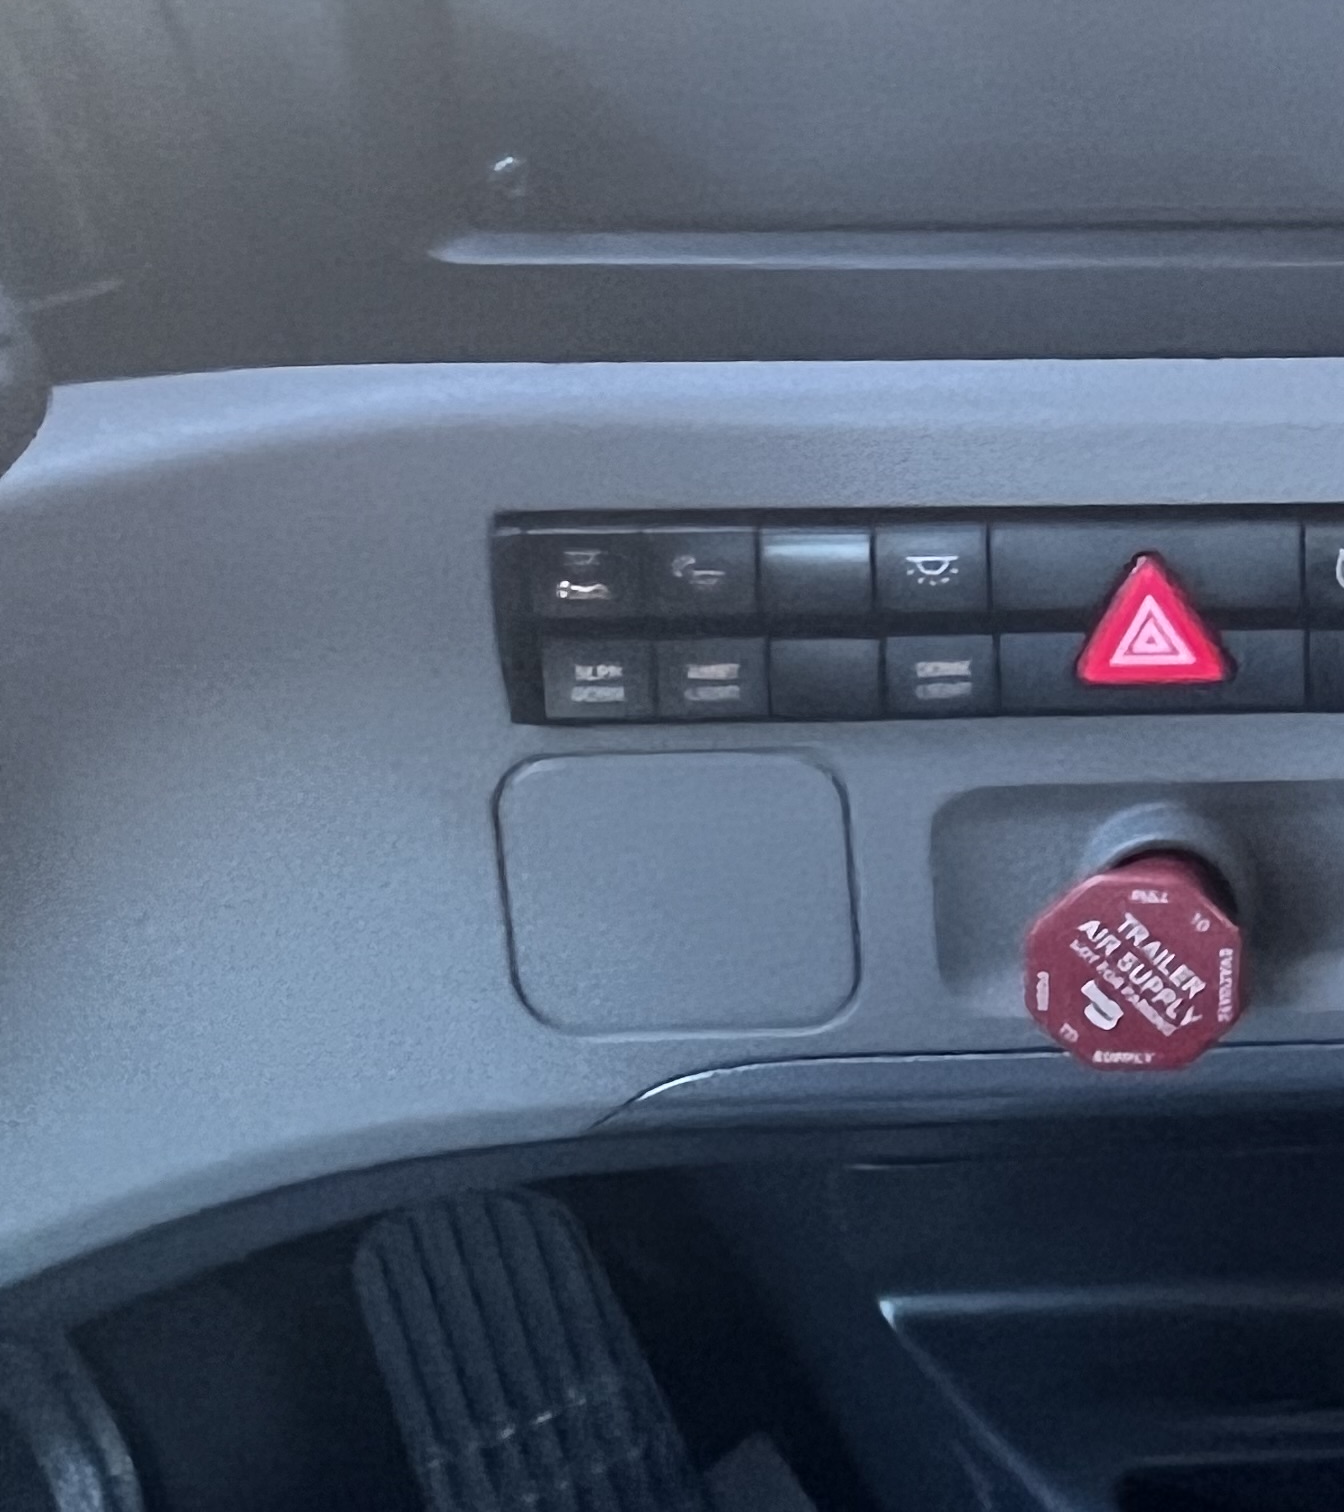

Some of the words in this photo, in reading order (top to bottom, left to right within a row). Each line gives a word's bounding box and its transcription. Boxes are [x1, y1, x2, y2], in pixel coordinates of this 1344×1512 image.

[1076, 920, 1122, 956] AIR
[1116, 951, 1203, 1026] SUPPLY
[1117, 912, 1206, 999] TRAILER
